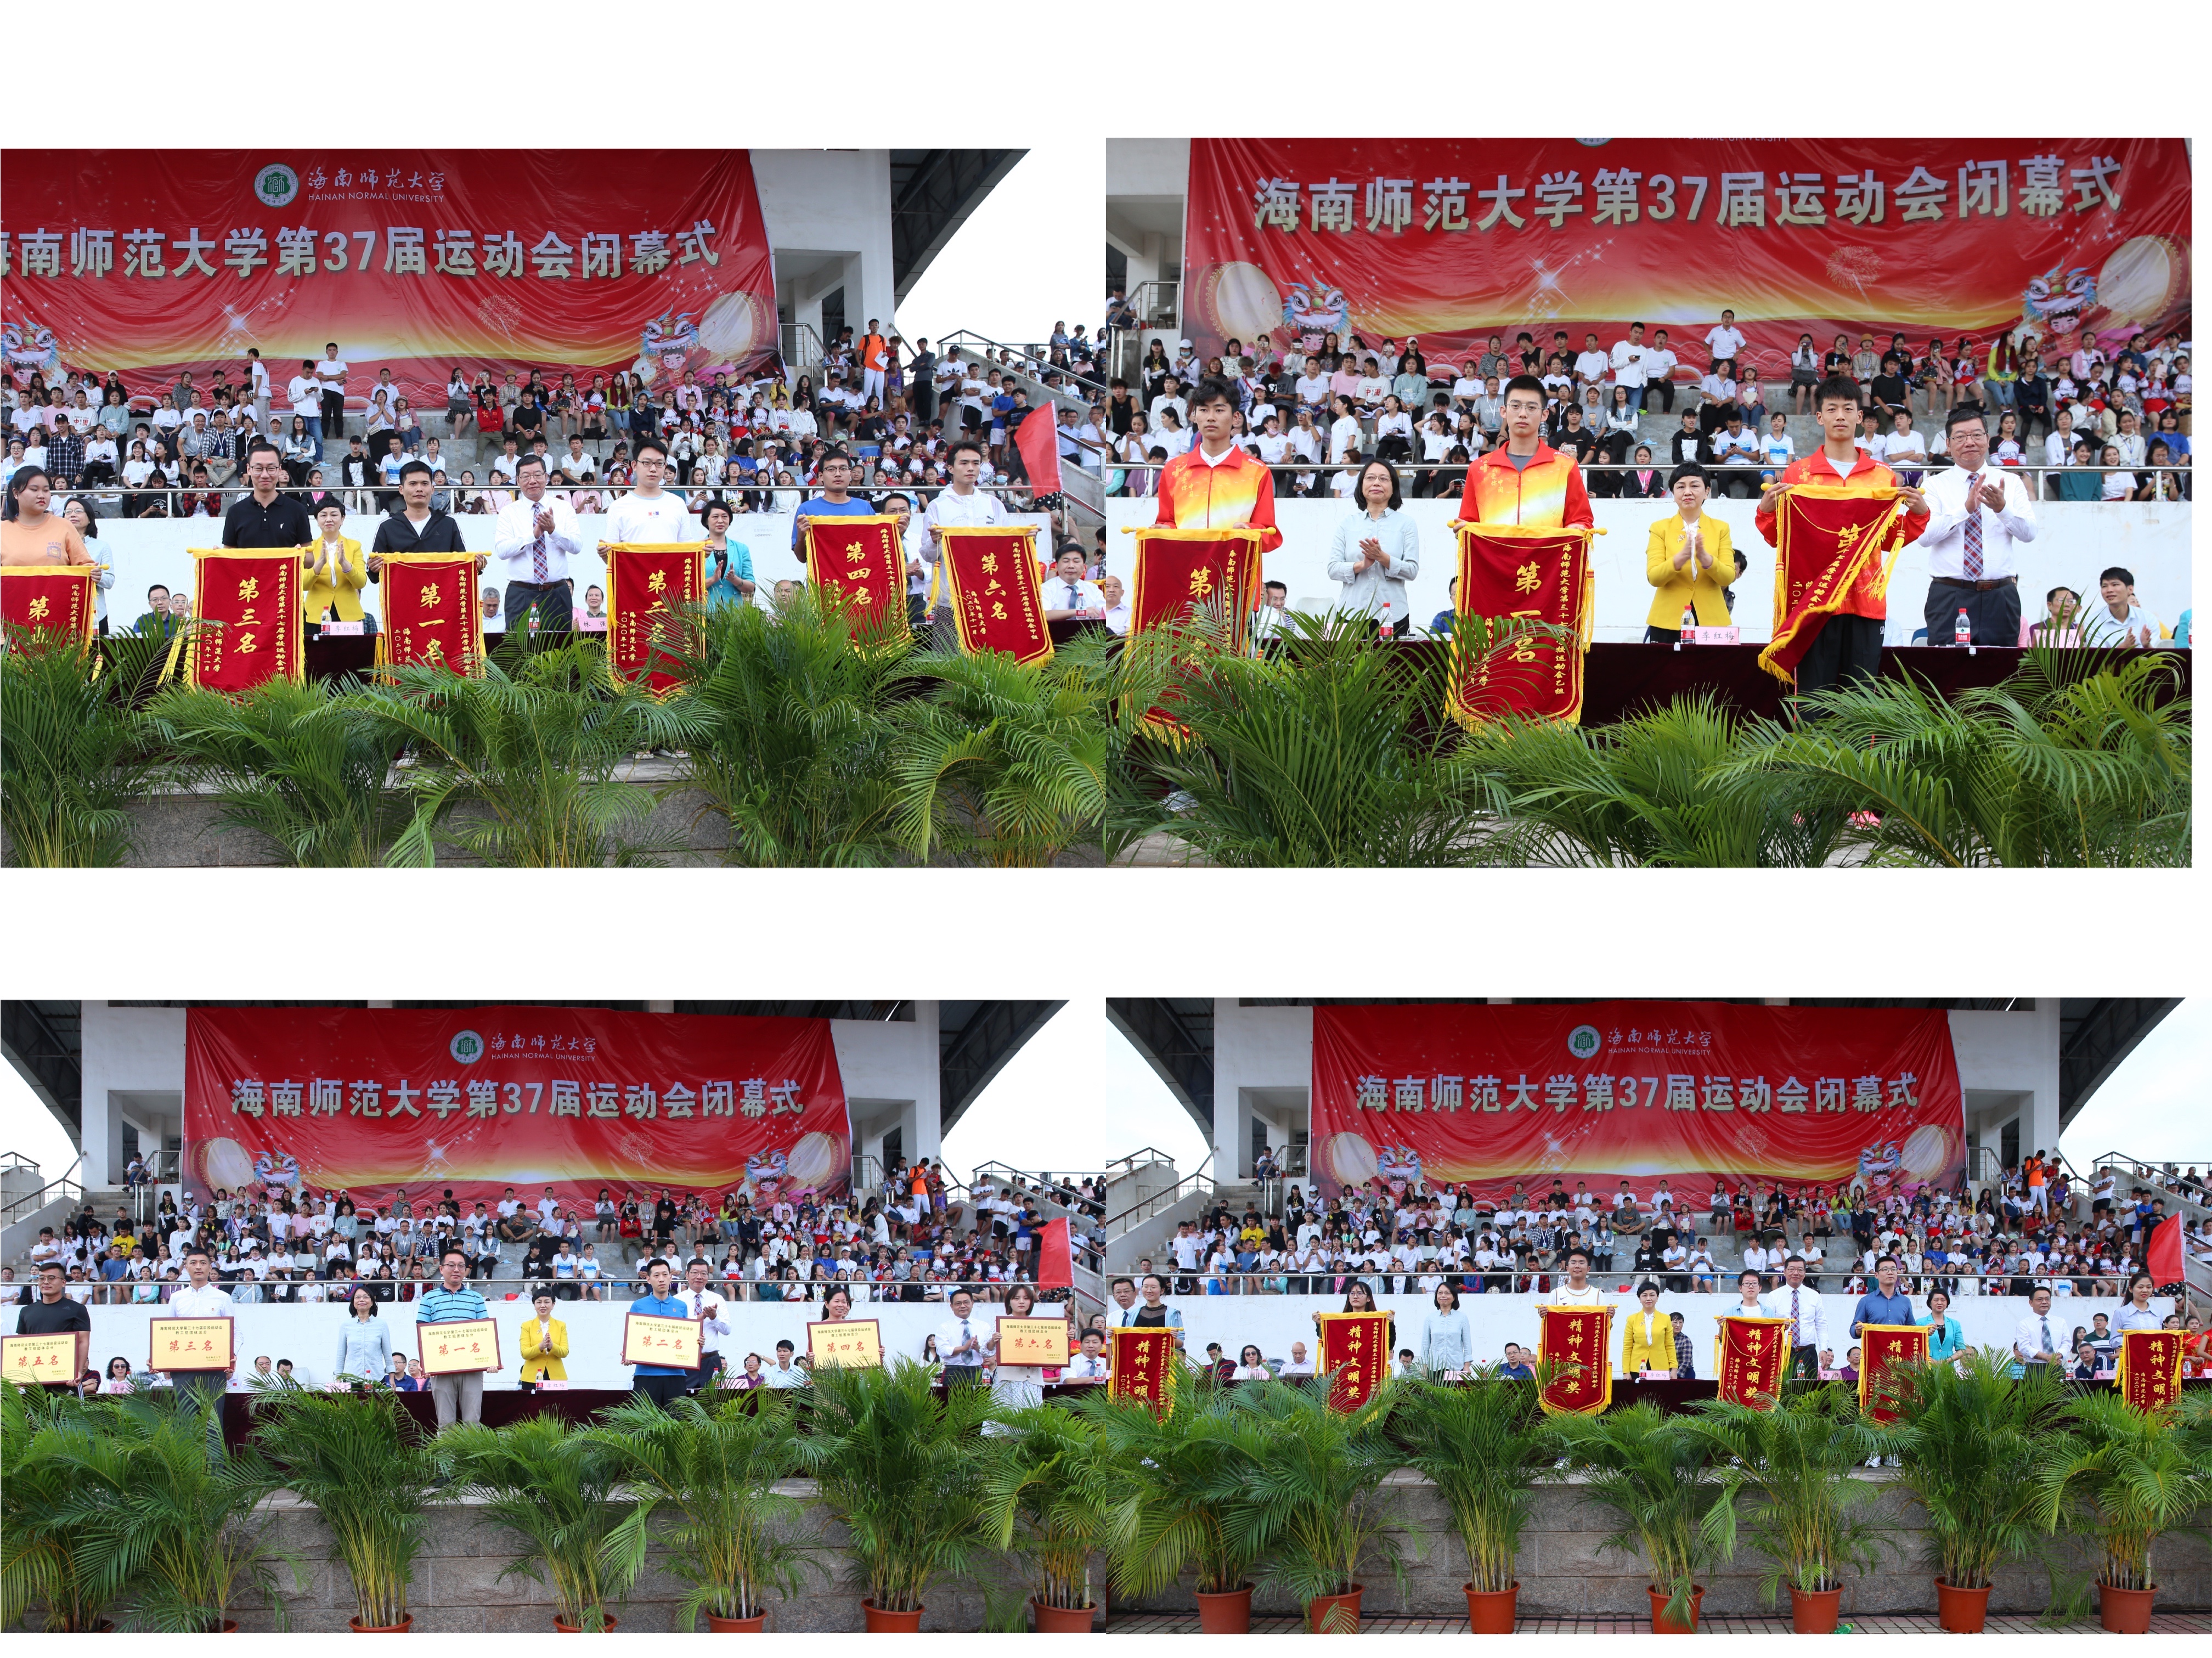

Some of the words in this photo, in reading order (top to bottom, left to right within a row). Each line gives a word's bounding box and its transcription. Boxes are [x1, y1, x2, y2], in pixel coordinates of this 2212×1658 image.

[308, 167, 445, 191] 海南师范大学
[348, 192, 389, 200] NORMAL
[392, 193, 444, 202] UNIVERSITY
[1254, 154, 2121, 232] 海南师范大学第37届运动会闭幕式
[1, 219, 719, 278] 南师范大学第37届运动会闭幕式
[846, 542, 873, 606] 第四名
[981, 552, 1008, 620] 第六名
[234, 577, 262, 654] 第三名
[418, 583, 445, 661] 第一名
[970, 591, 987, 635] 海南师范大学
[1507, 561, 1542, 663] 第一名
[1701, 630, 1735, 641] 李红梅
[492, 1033, 596, 1053] 海南师范大学
[1608, 1027, 1712, 1047] 海南师范大学
[231, 1078, 804, 1119] 海南师范大学第37届运动会闭幕式
[1357, 1072, 1919, 1113] 海南师范大学第37届运动会闭幕式
[18, 1355, 59, 1369] 第五名
[169, 1340, 213, 1353] 第三名
[438, 1342, 481, 1357] 第一名
[642, 1335, 682, 1350] 第二名
[827, 1341, 865, 1354] 第四名
[1014, 1337, 1053, 1349] 第六名
[1346, 1324, 1363, 1398] 精神文明奖
[1565, 1318, 1584, 1394] 精神文明奖
[1743, 1328, 1763, 1399] 精神文明奖
[2148, 1340, 2166, 1409] 精神文明奖
